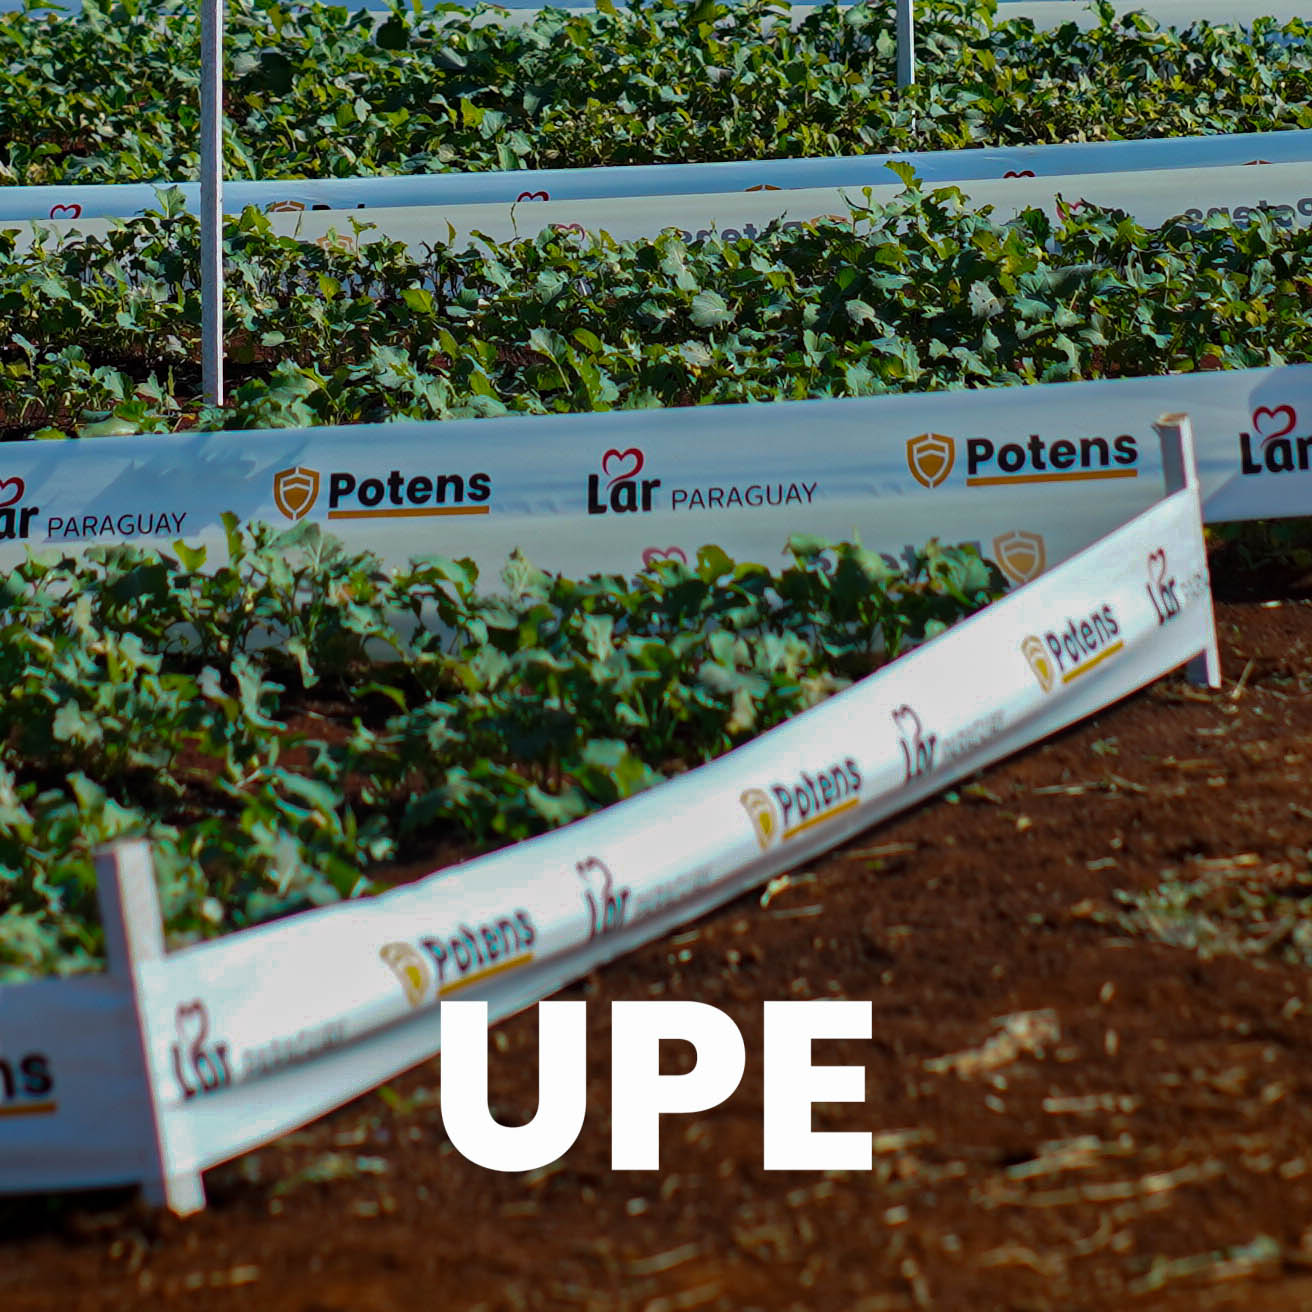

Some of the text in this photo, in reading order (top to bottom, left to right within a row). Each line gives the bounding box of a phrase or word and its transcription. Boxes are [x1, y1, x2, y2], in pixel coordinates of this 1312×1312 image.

[966, 433, 1139, 475] Potens
[328, 468, 492, 509] Potens
[587, 473, 818, 515] Lar PARAGUAY
[47, 511, 188, 538] PARAGUAY
[1045, 604, 1120, 672] Potens
[771, 757, 862, 827] Potens
[419, 909, 537, 982] Potens
[171, 1041, 231, 1101] Lar
